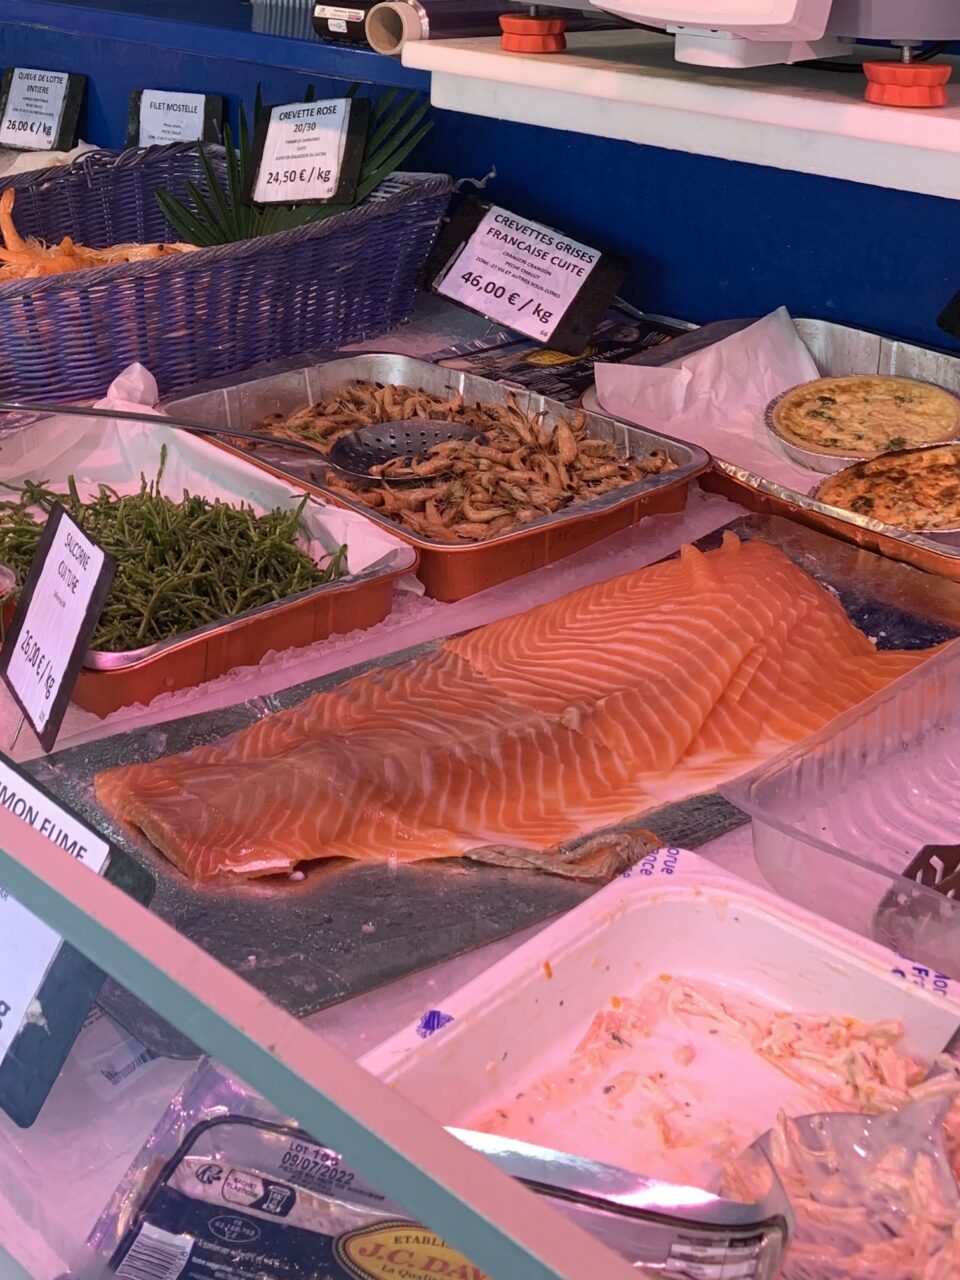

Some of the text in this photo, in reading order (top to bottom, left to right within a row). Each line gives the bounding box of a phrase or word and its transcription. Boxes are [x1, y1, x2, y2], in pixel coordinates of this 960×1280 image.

[38, 74, 46, 82] DE
[46, 75, 64, 84] LOTTE
[150, 102, 198, 114] FILET MOSTELLE
[279, 105, 338, 121] CREVETTE ROSE
[6, 119, 28, 132] 26,00
[30, 122, 36, 132] €
[43, 122, 52, 136] kg
[293, 122, 316, 133] 20/30
[267, 166, 331, 185] 24,50 € / kg
[486, 227, 586, 277] FRANCAISE CUITE
[494, 214, 595, 264] CREVETTES GRISES
[475, 256, 489, 265] ZONE
[512, 272, 530, 285] AUTRES
[530, 281, 561, 299] SOUS-ZONES
[502, 251, 552, 276] CRANGON CRANGON
[461, 271, 553, 324] 46,00 € / kg
[64, 532, 91, 572] SALICORNE
[58, 560, 80, 595] CULTURE
[20, 630, 40, 665] 26,00
[37, 655, 46, 676] €
[45, 669, 56, 700] kg
[290, 1142, 309, 1155] LOT
[281, 1151, 355, 1185] 09/07/2022
